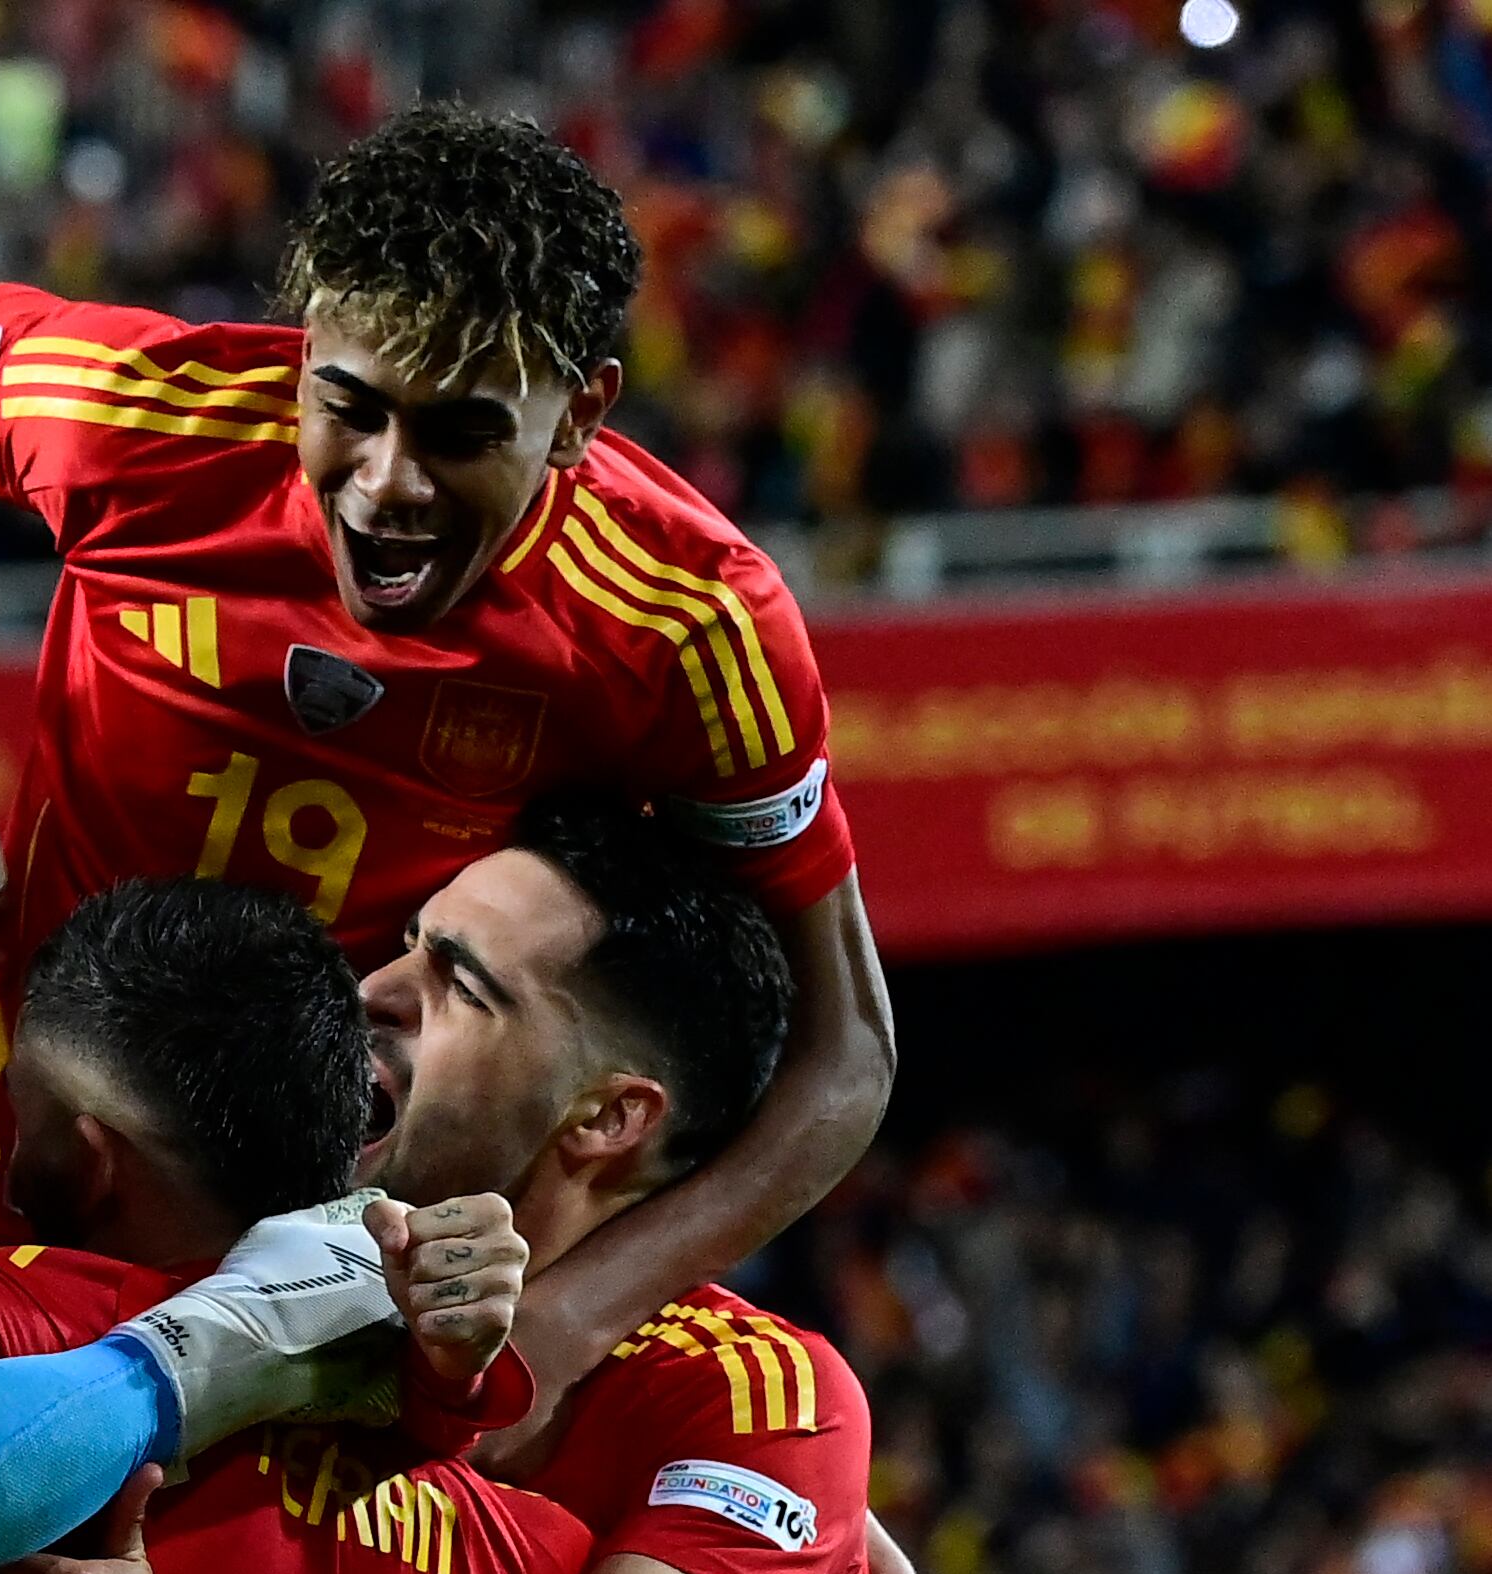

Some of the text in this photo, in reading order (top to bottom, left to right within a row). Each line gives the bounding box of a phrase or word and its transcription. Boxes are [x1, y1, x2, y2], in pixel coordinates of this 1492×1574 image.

[185, 750, 367, 924] 19
[152, 1310, 190, 1339] UNAI
[656, 1477, 772, 1515] FOUNDATION
